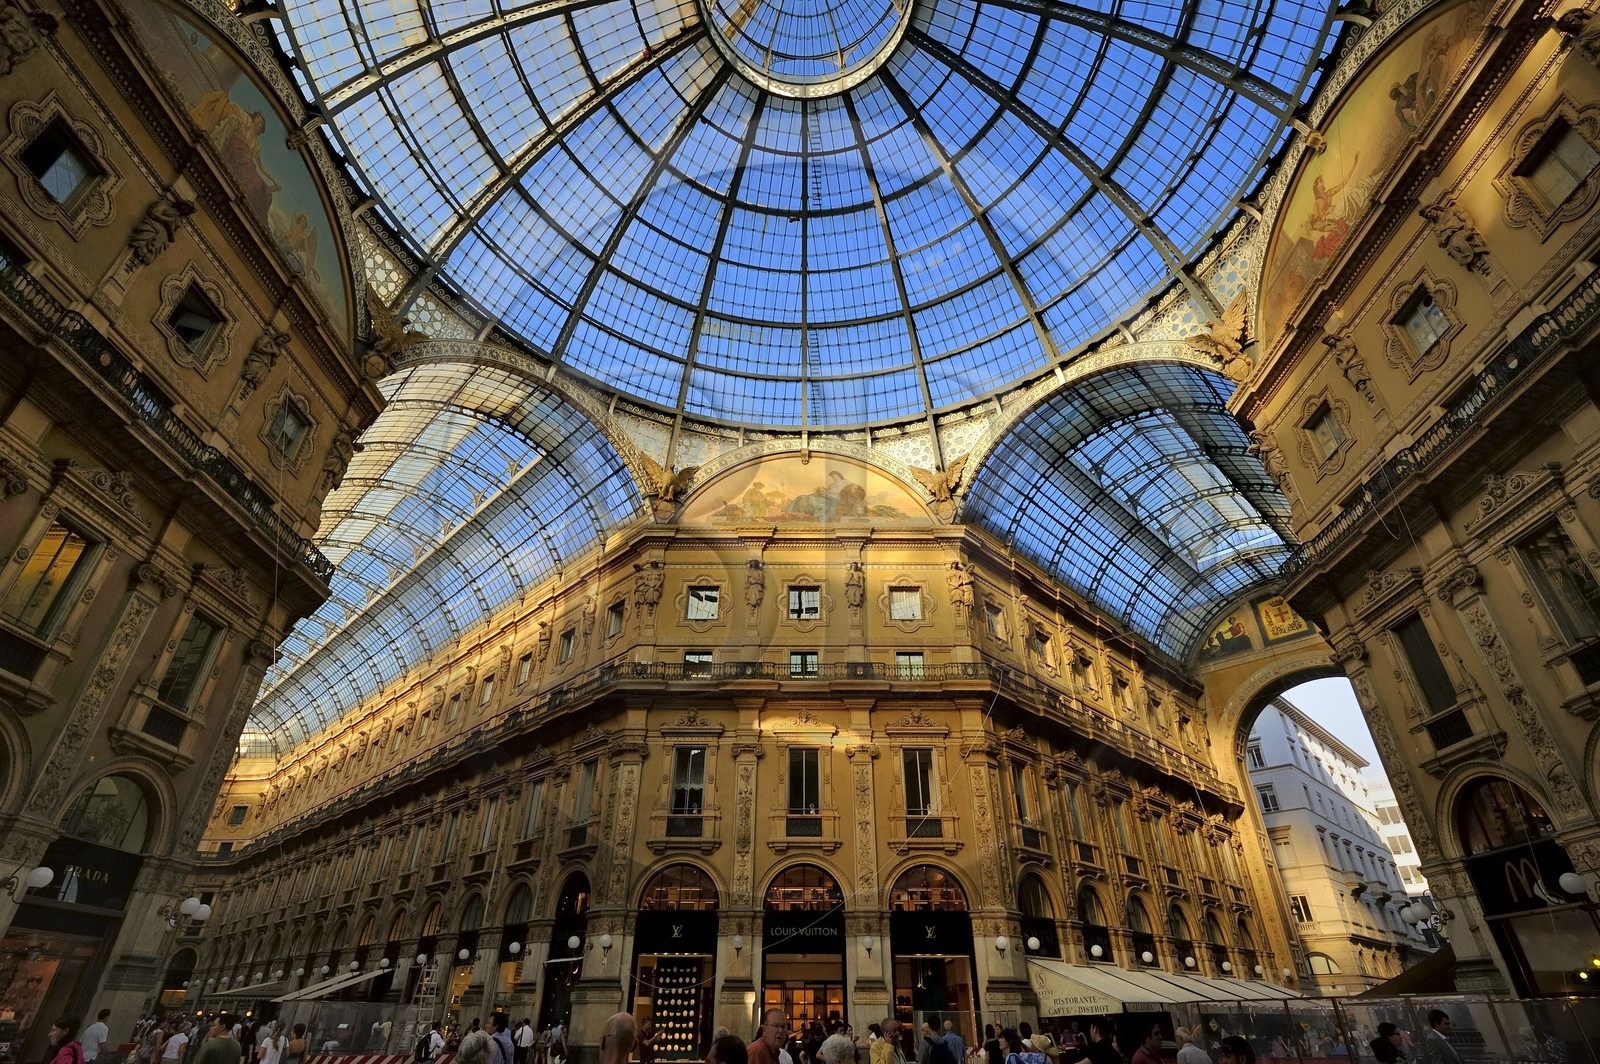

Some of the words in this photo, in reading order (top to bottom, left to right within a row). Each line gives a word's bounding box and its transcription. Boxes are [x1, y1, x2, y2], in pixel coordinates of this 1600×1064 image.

[64, 864, 109, 883] PRADA
[770, 927, 796, 936] LOUIS
[799, 927, 838, 936] VUITTON
[1053, 995, 1098, 1006] RISTORANTE
